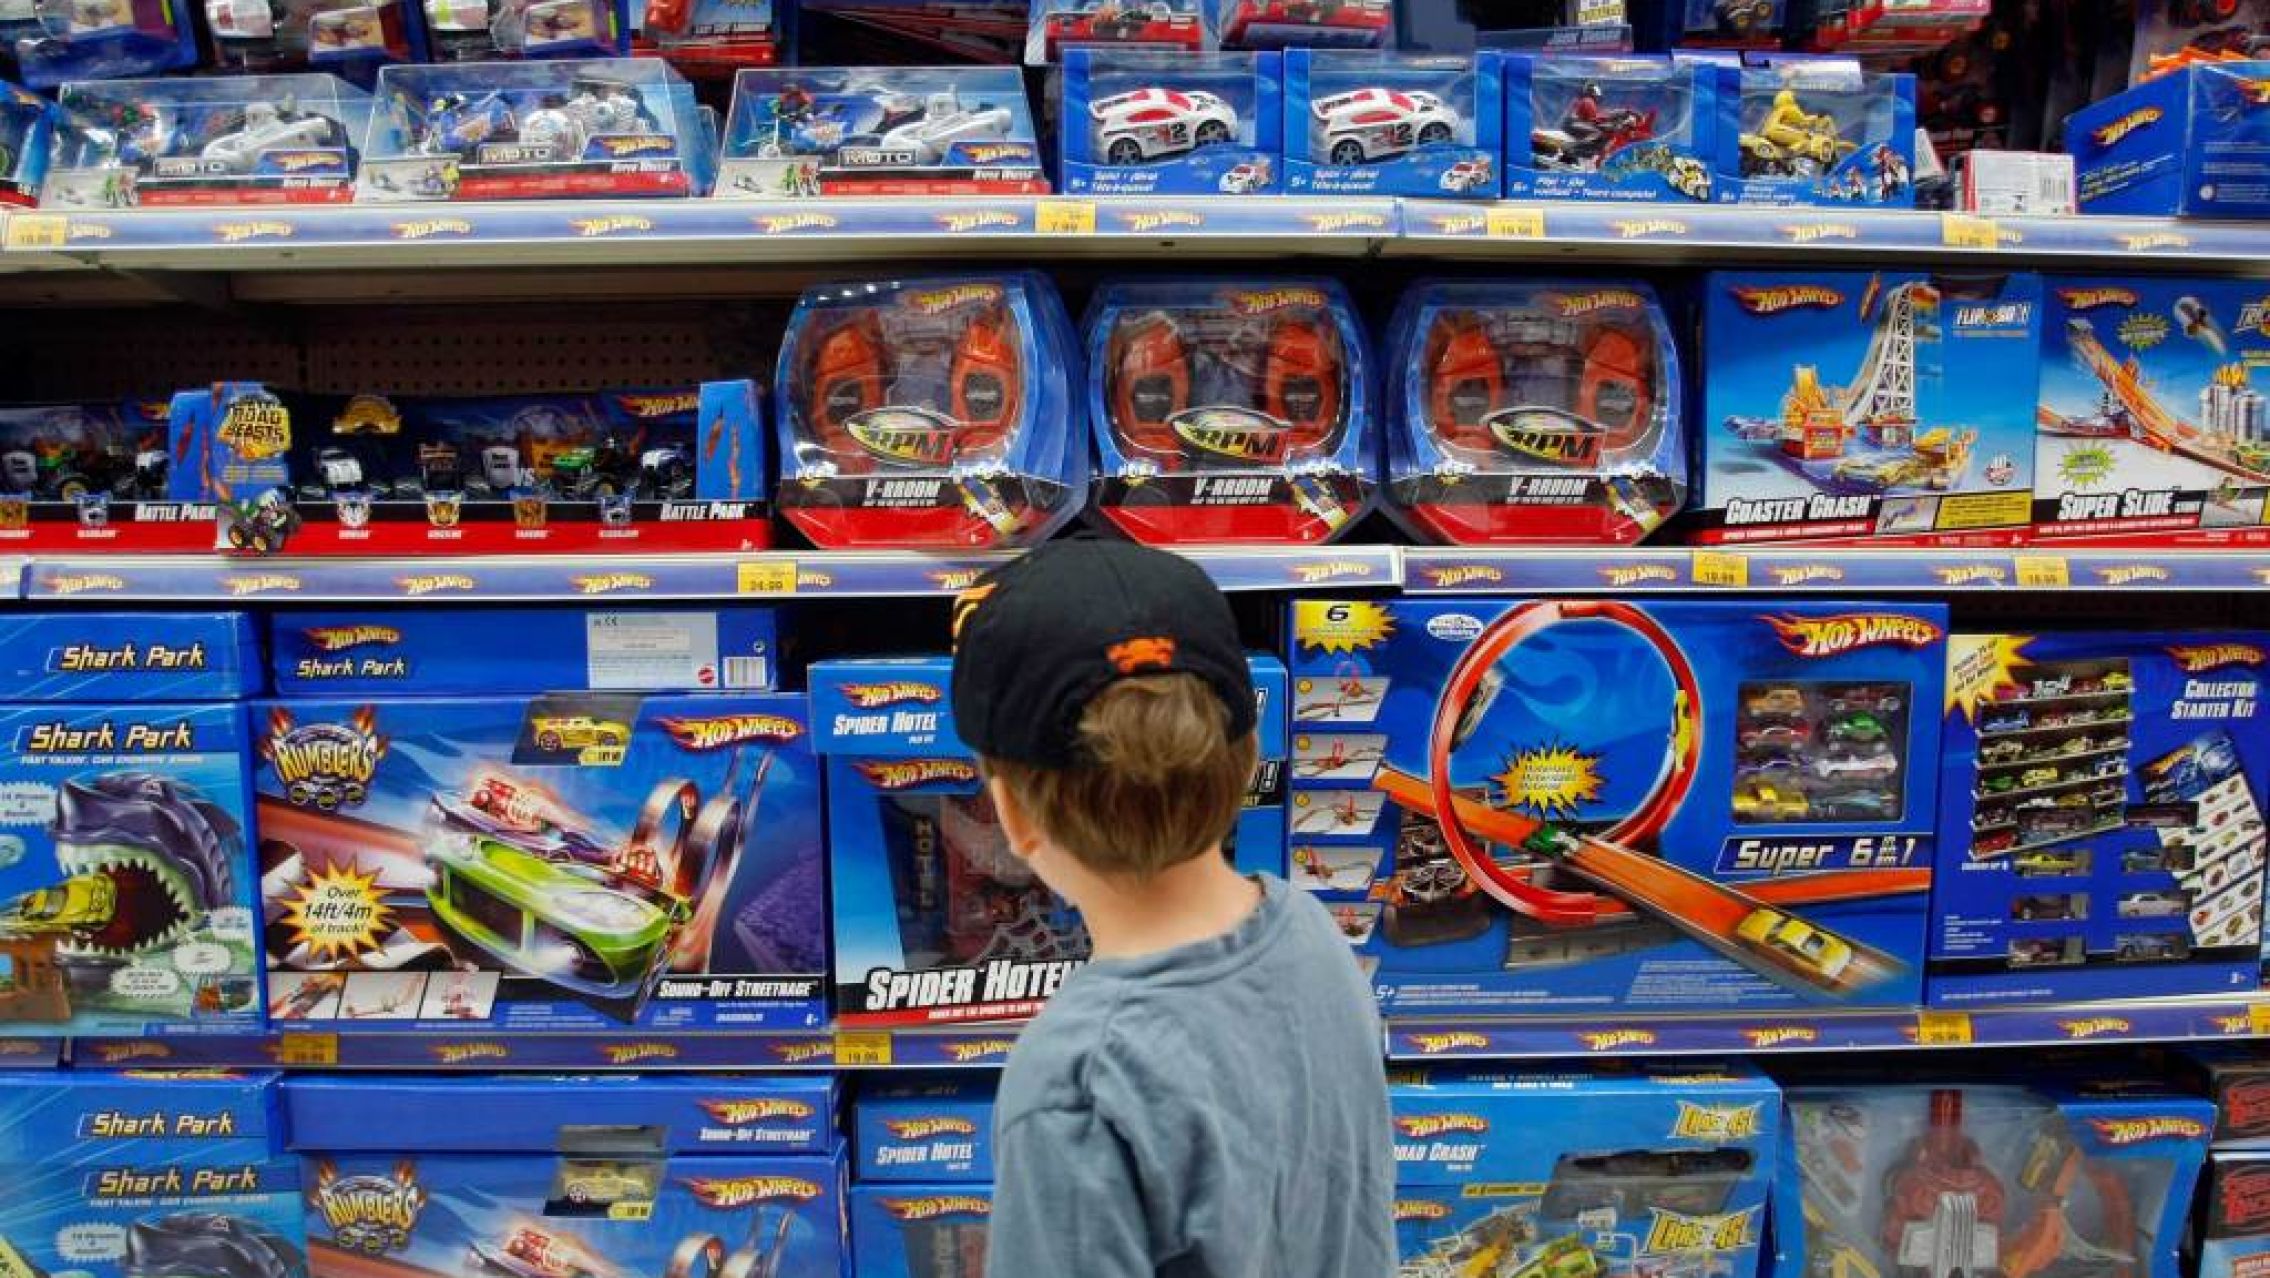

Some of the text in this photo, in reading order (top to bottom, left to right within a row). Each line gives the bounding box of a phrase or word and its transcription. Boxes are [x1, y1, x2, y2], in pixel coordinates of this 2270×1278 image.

[660, 503, 707, 521] BATTLE
[1724, 494, 1871, 524] COASTER CRASH
[2058, 492, 2119, 521] SUPER
[1327, 605, 1351, 622] 6
[1803, 614, 1934, 656] HOT WHEELS
[61, 642, 205, 671] Shark Park
[296, 658, 405, 678] Shark Park
[29, 720, 193, 753] Shark Park
[693, 714, 796, 748] HOT WHEELS
[832, 711, 937, 736] SPIDER HOTEL
[1734, 840, 1835, 876] Super
[1849, 838, 1873, 866] 6
[1901, 838, 1917, 866] 1
[327, 886, 362, 899] Over
[303, 904, 373, 919] 14ft/4m
[866, 968, 978, 1011] SPIDER
[92, 1111, 234, 1136] Shark Park
[98, 1165, 258, 1197] Shark Park
